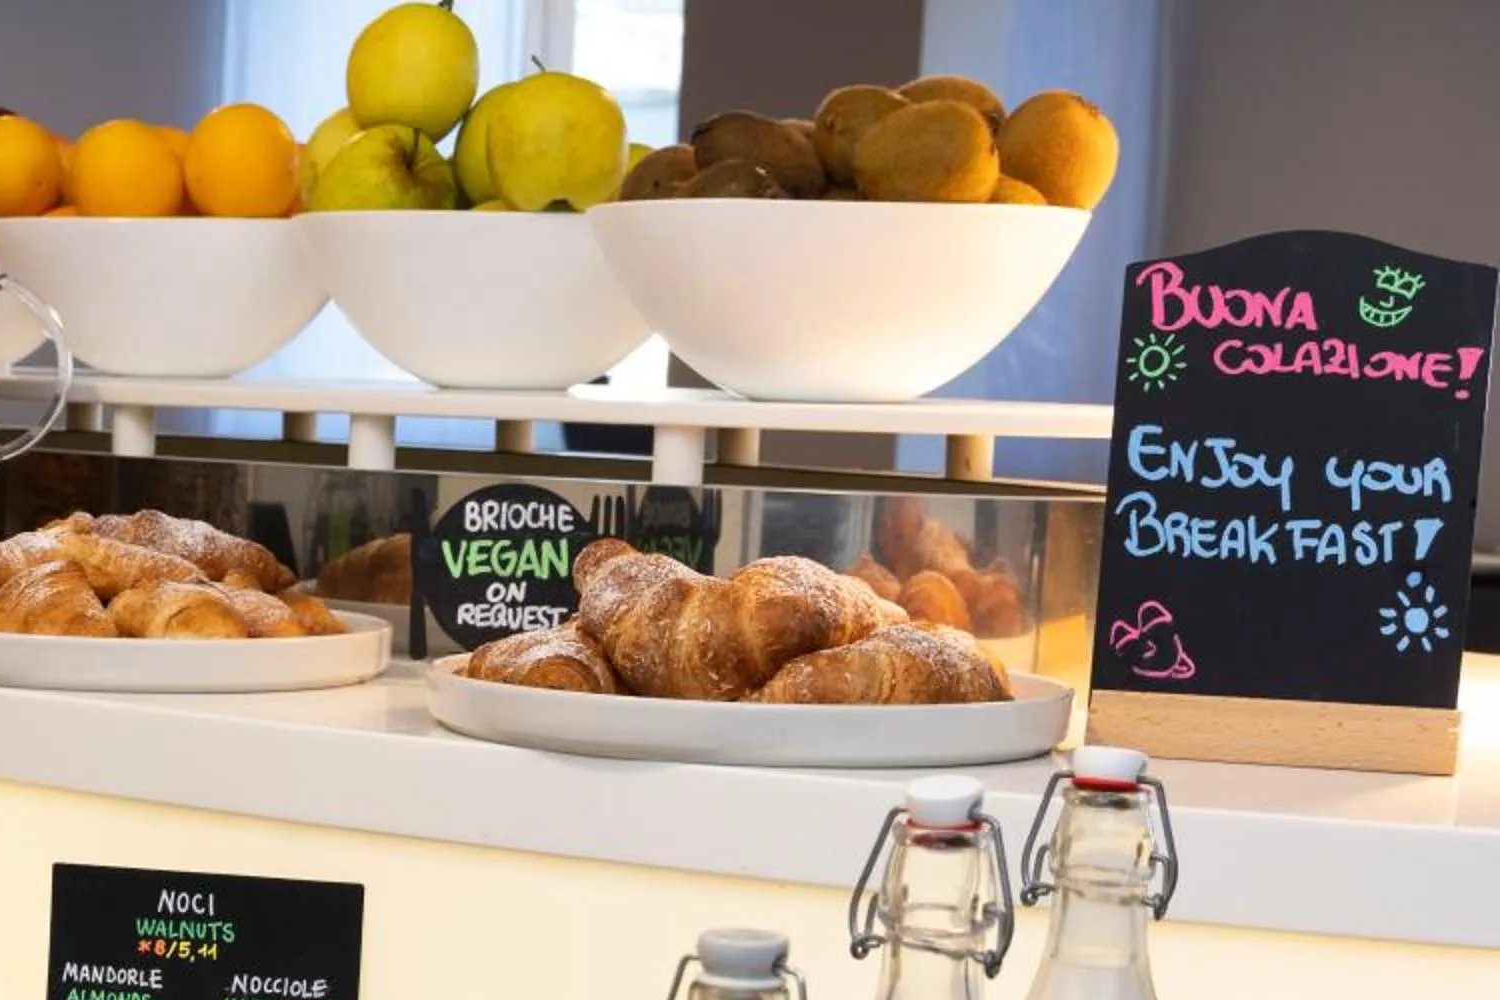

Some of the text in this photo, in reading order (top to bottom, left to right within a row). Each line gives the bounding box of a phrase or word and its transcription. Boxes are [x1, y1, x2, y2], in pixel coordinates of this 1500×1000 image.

[1136, 261, 1319, 331] BUONA
[463, 501, 575, 533] BRIOCHE
[441, 537, 569, 580] VEGAN
[486, 582, 528, 602] ON
[456, 603, 568, 631] REQUEST
[157, 889, 215, 916] NOCI
[136, 918, 235, 943] WALNUTS
[62, 962, 164, 989] MANDORLE
[231, 974, 329, 999] NOCCIOLE
